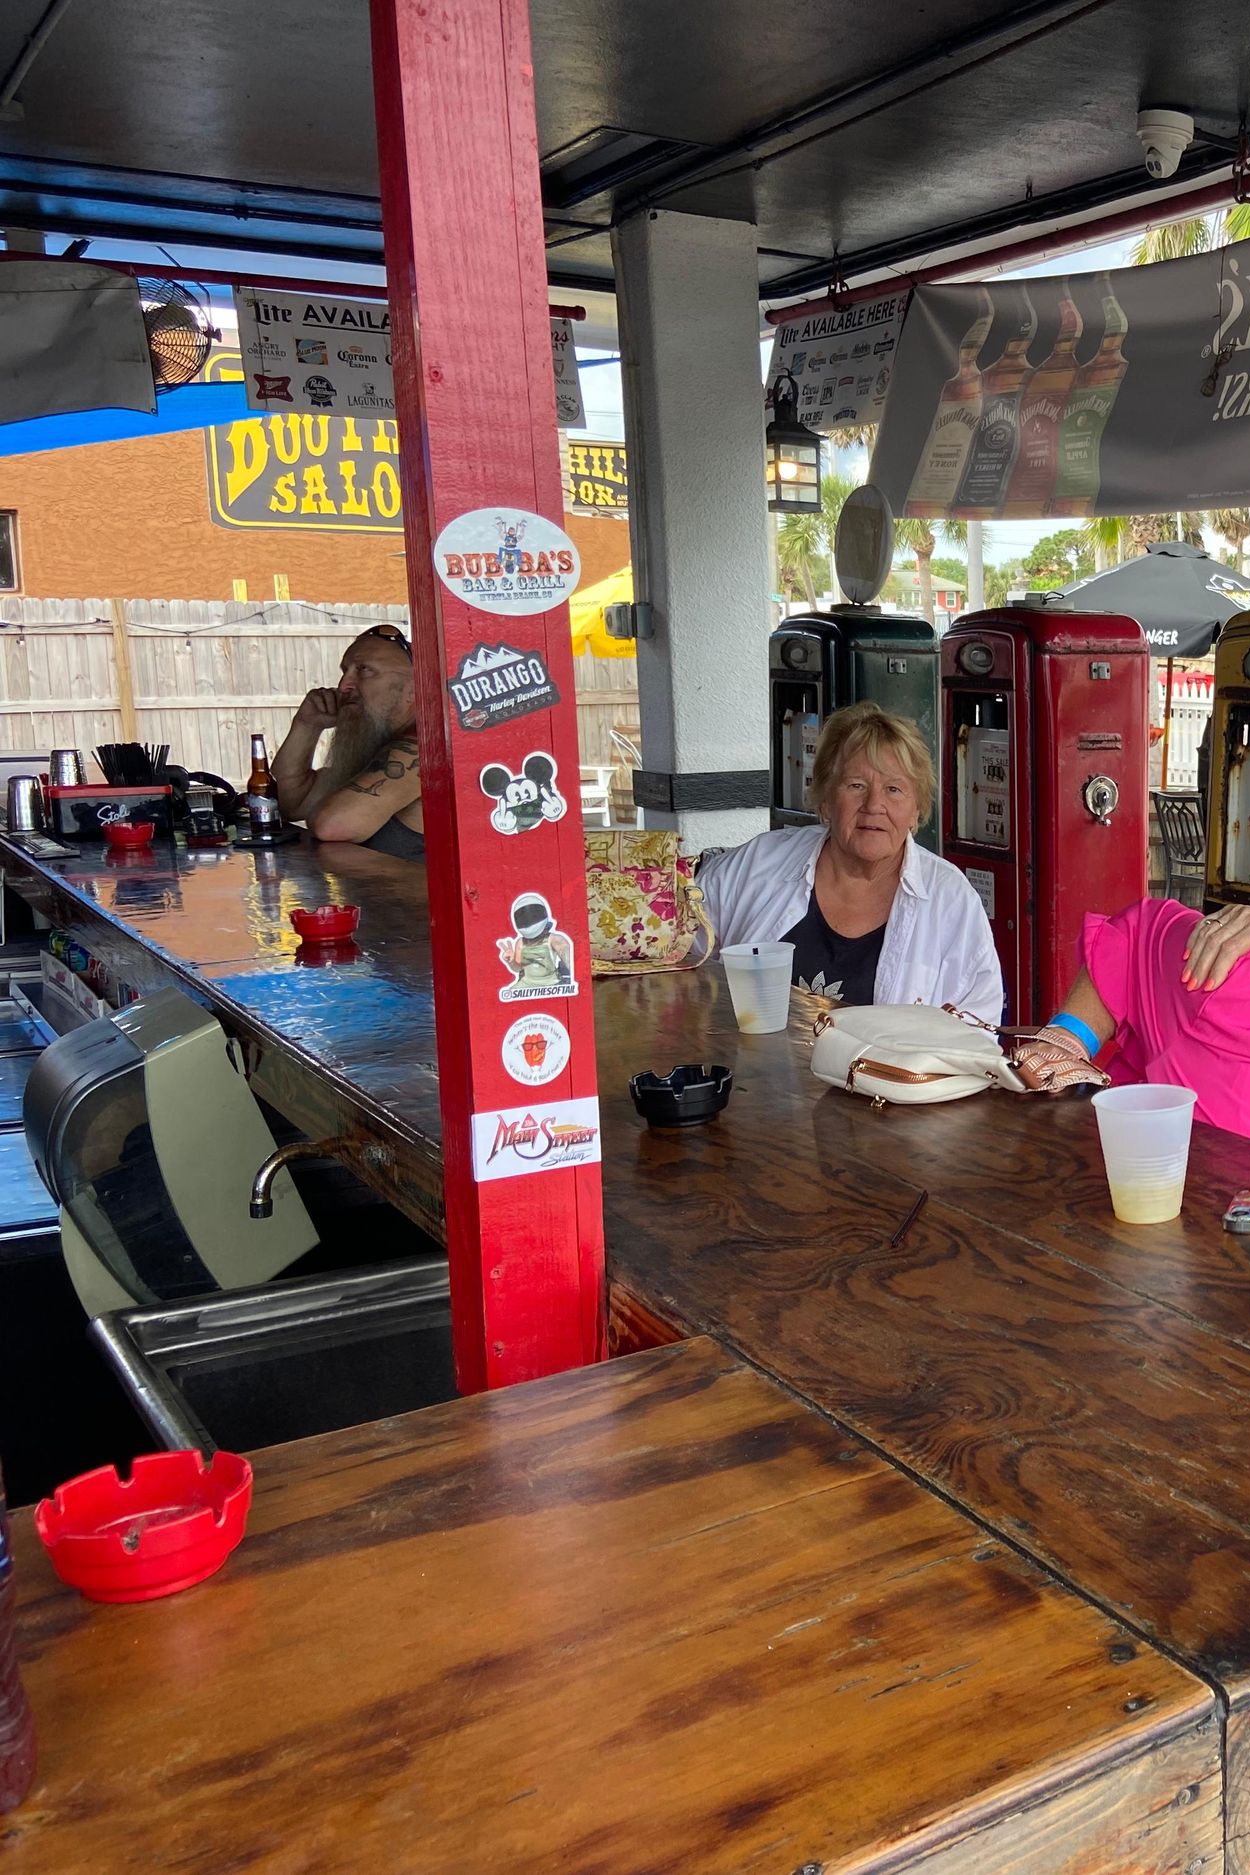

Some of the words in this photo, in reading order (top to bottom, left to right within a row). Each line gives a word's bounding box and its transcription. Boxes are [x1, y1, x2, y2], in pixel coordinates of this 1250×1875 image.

[255, 302, 292, 325] Lite
[303, 304, 391, 330] AVAILA
[802, 307, 865, 338] AVAILABLE
[867, 299, 896, 322] HERE
[247, 347, 286, 358] ORCHARD
[337, 350, 378, 363] Corona
[347, 395, 395, 409] LAGUNITAS
[269, 460, 402, 518] SALO
[444, 550, 575, 579] BUBBA'S
[462, 578, 497, 592] BAR
[500, 577, 513, 591] &
[516, 574, 566, 590] GRILL
[1145, 630, 1179, 646] NGER
[451, 658, 546, 712] DURANGO
[97, 803, 131, 827] Stoli
